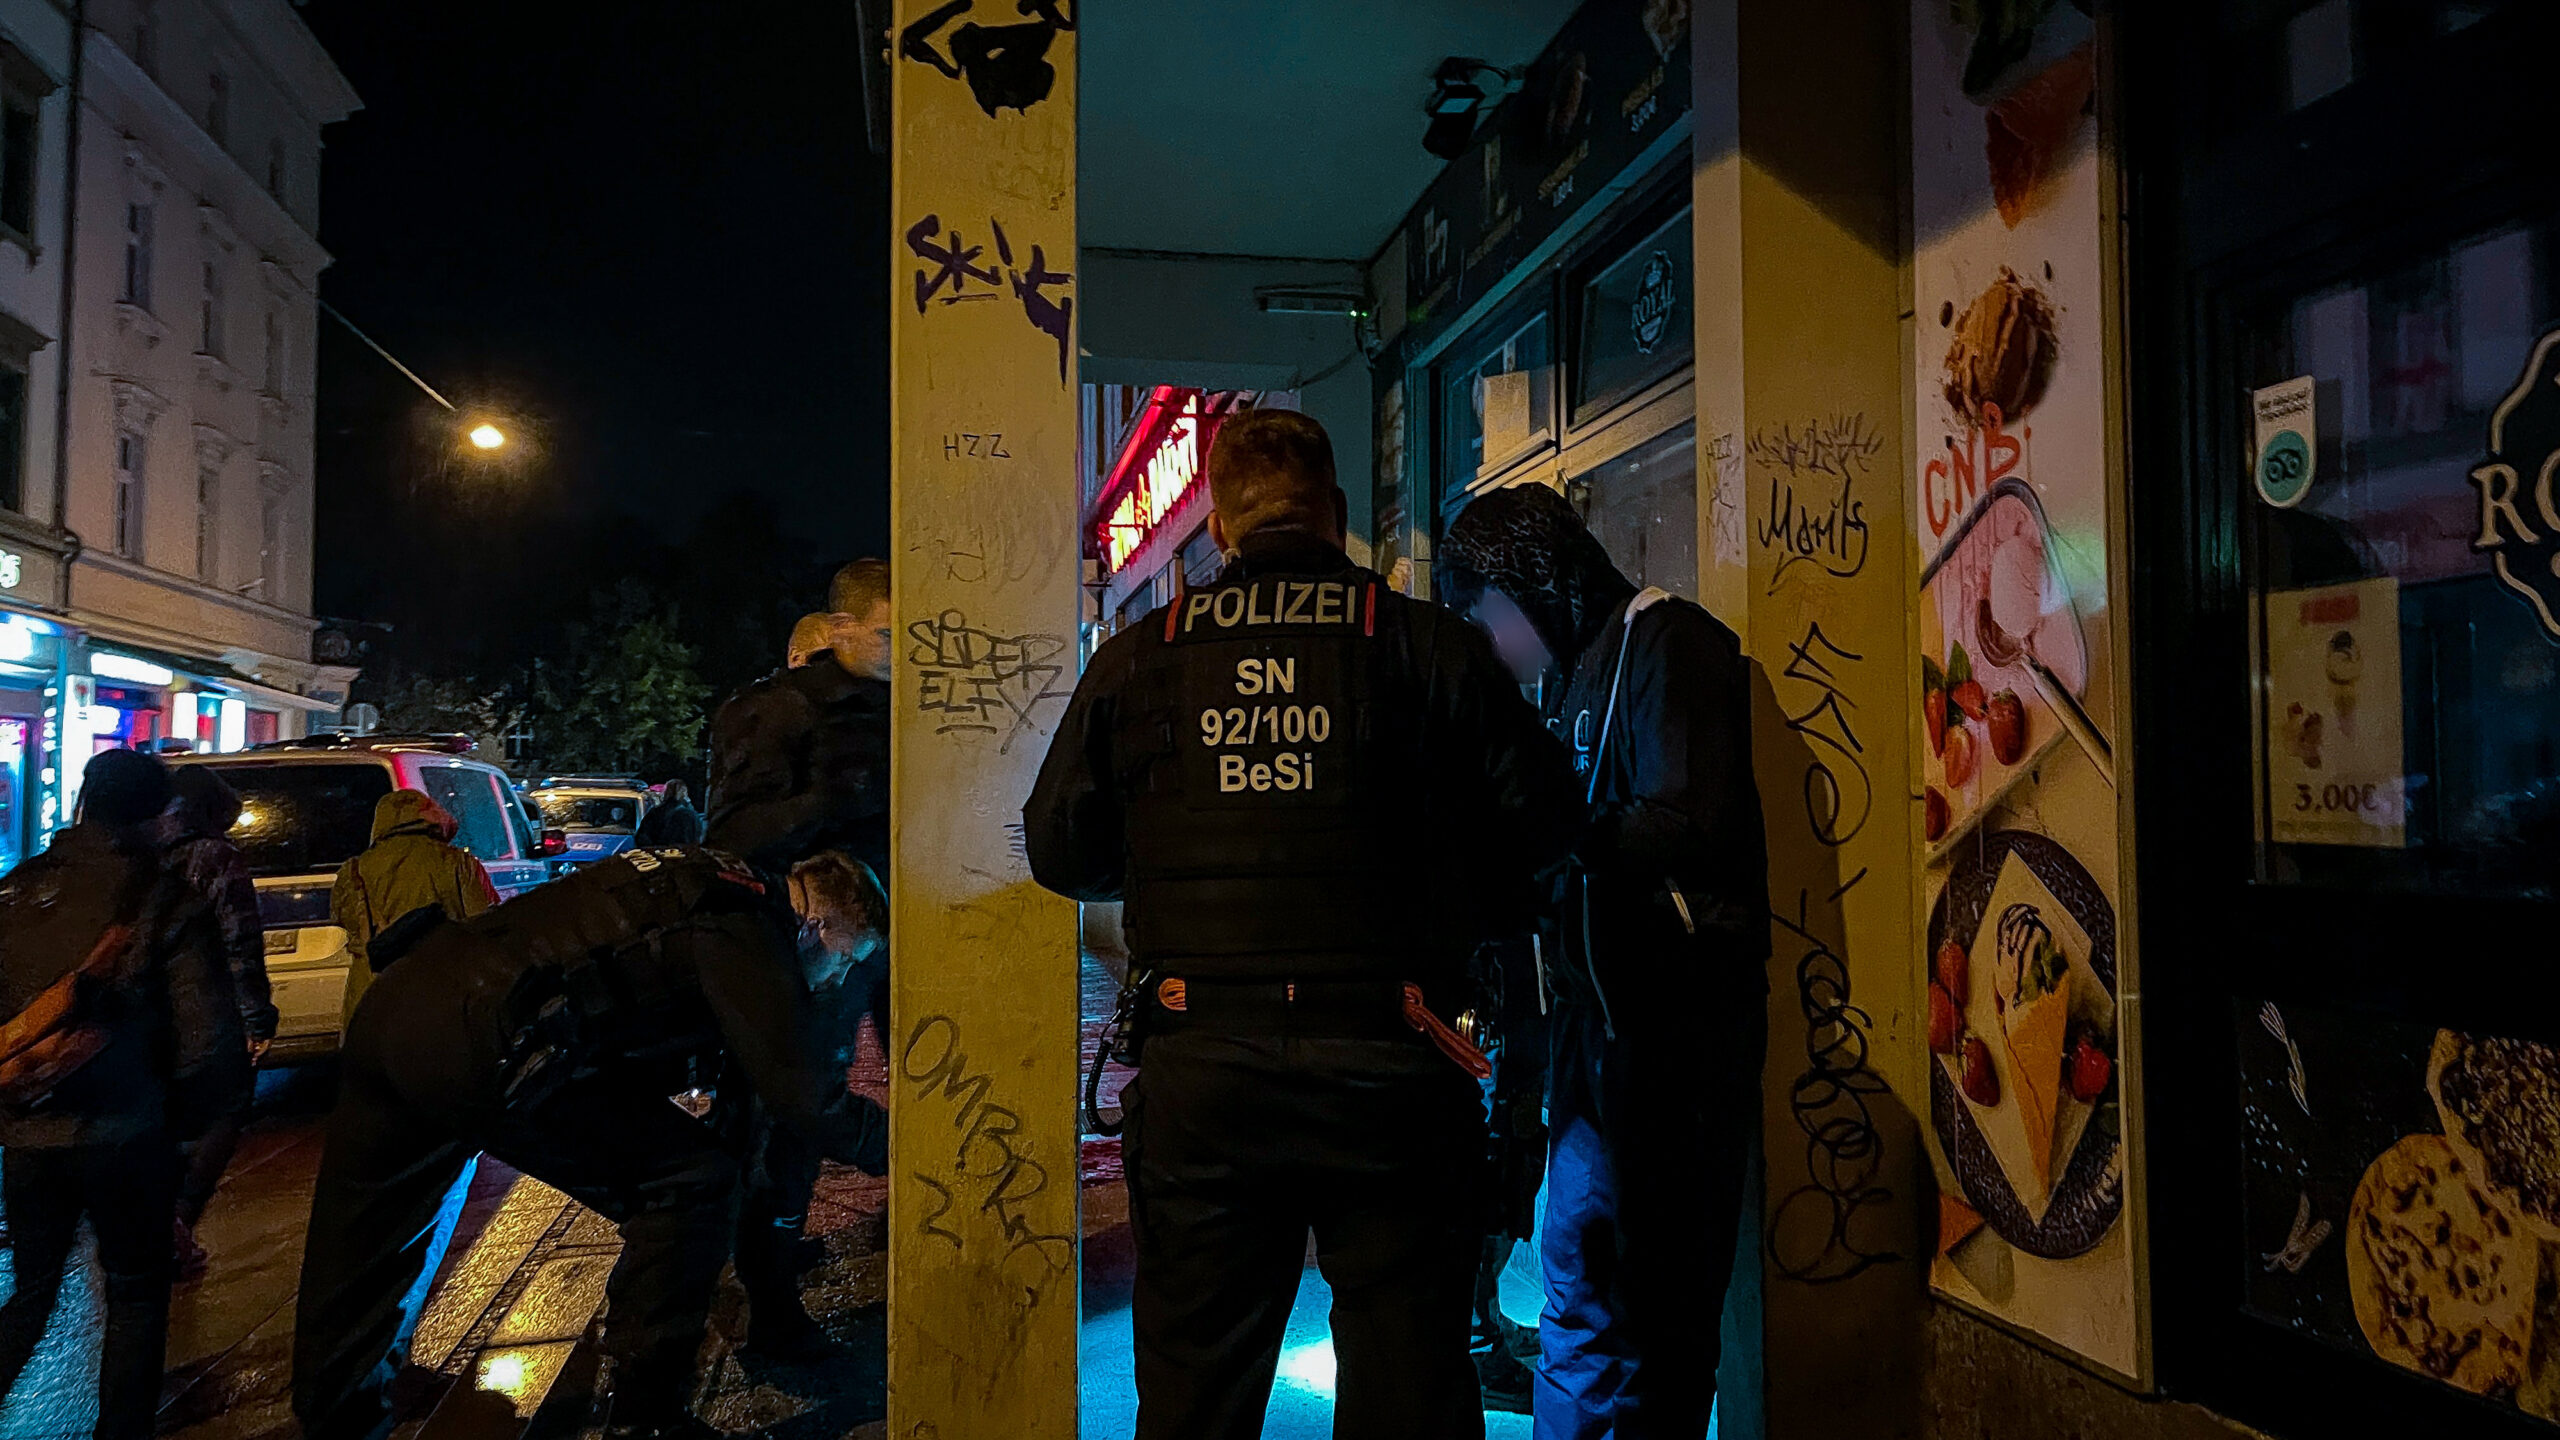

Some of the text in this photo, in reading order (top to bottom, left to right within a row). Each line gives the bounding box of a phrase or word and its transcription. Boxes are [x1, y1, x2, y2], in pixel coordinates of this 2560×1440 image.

[1184, 577, 1356, 633] POLIZEI
[1235, 657, 1295, 695] SN
[1200, 705, 1331, 746] 92/100
[1219, 752, 1314, 792] BeSi
